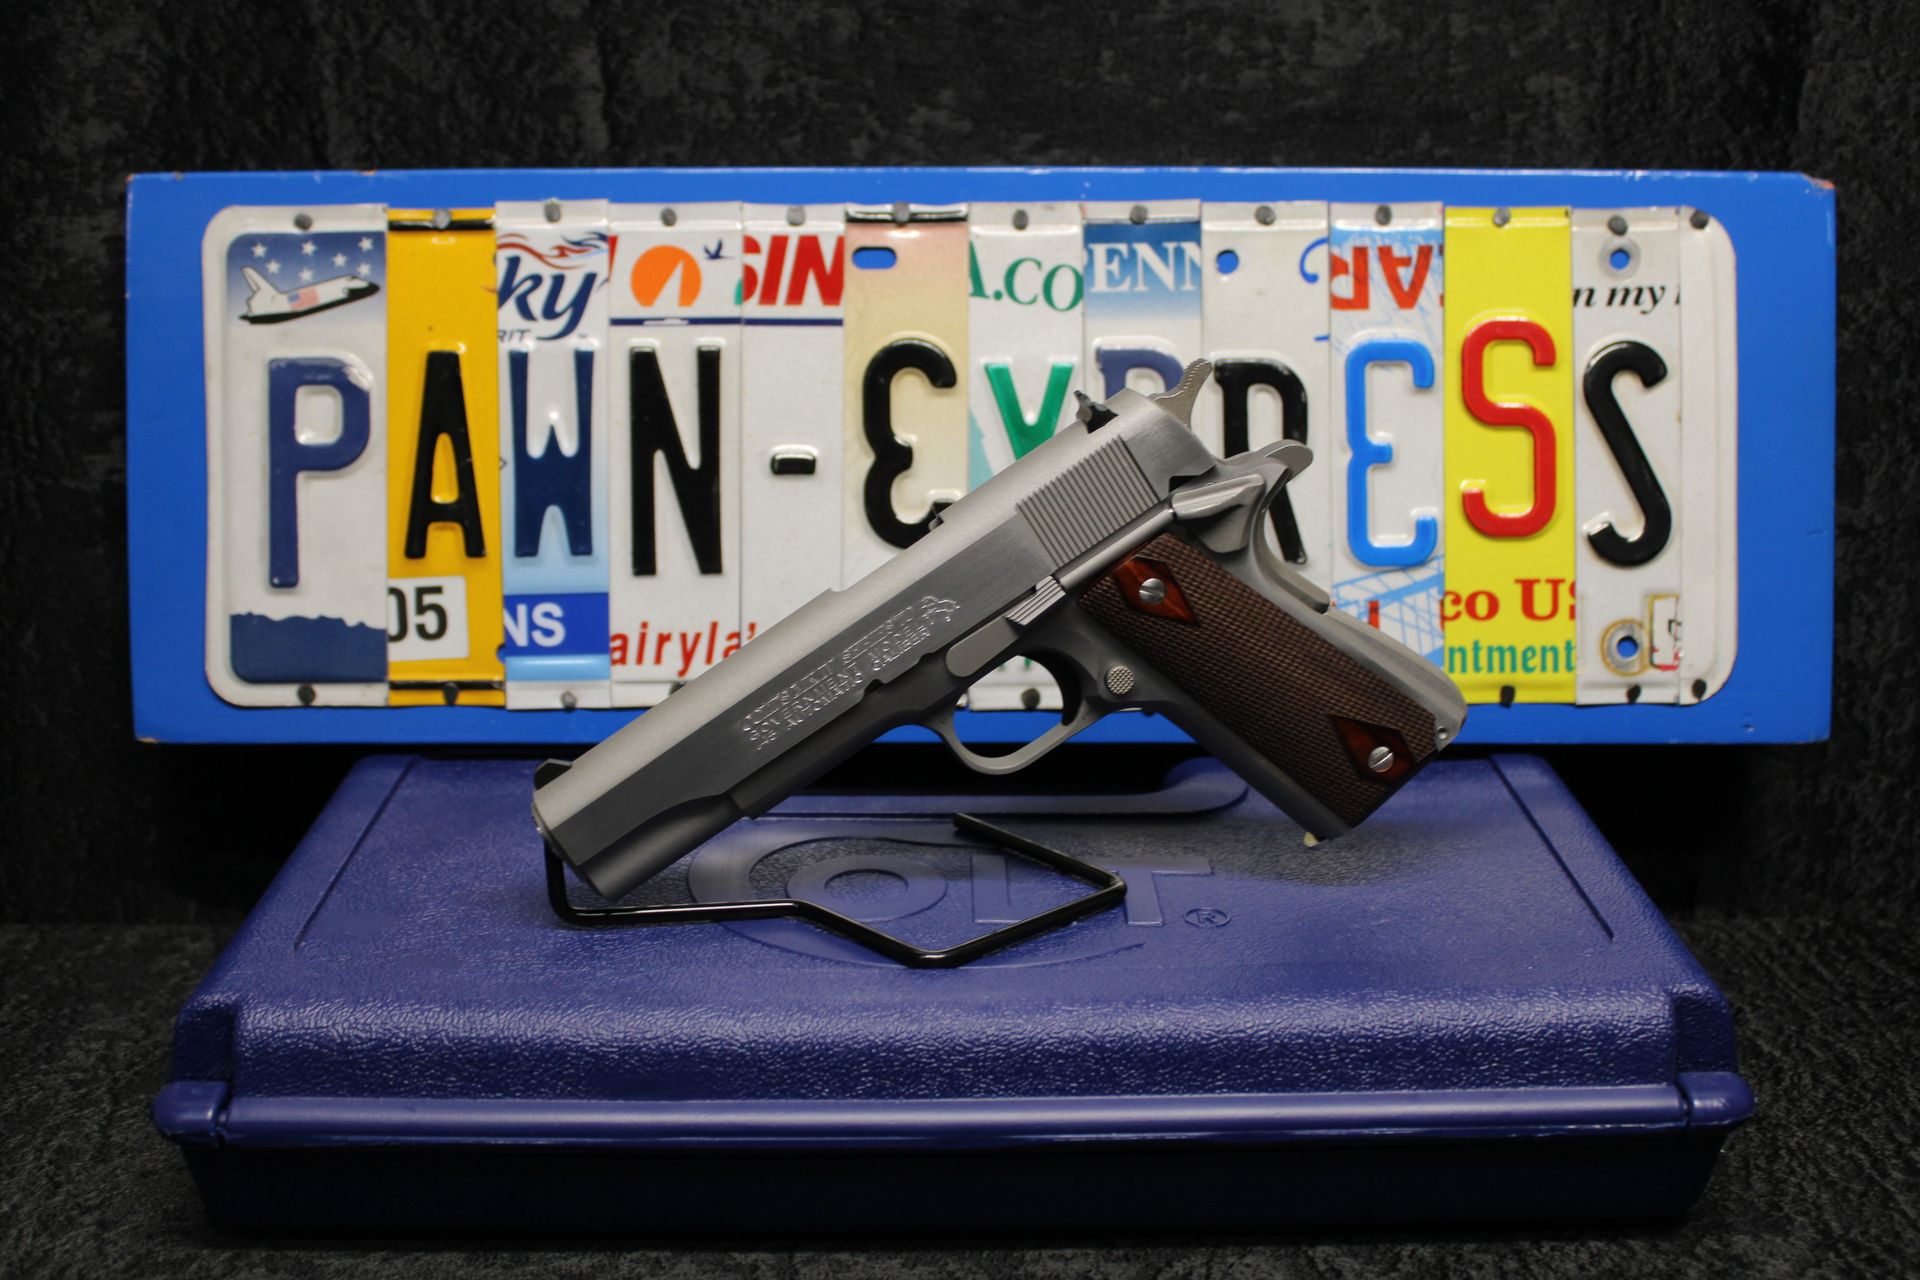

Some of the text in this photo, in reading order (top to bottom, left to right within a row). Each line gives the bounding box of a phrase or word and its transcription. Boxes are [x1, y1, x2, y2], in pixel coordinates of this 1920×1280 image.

[1084, 242, 1202, 292] ENN
[498, 255, 597, 341] ky
[1606, 285, 1666, 315] my
[1515, 578, 1576, 622] U
[504, 602, 566, 647] NS
